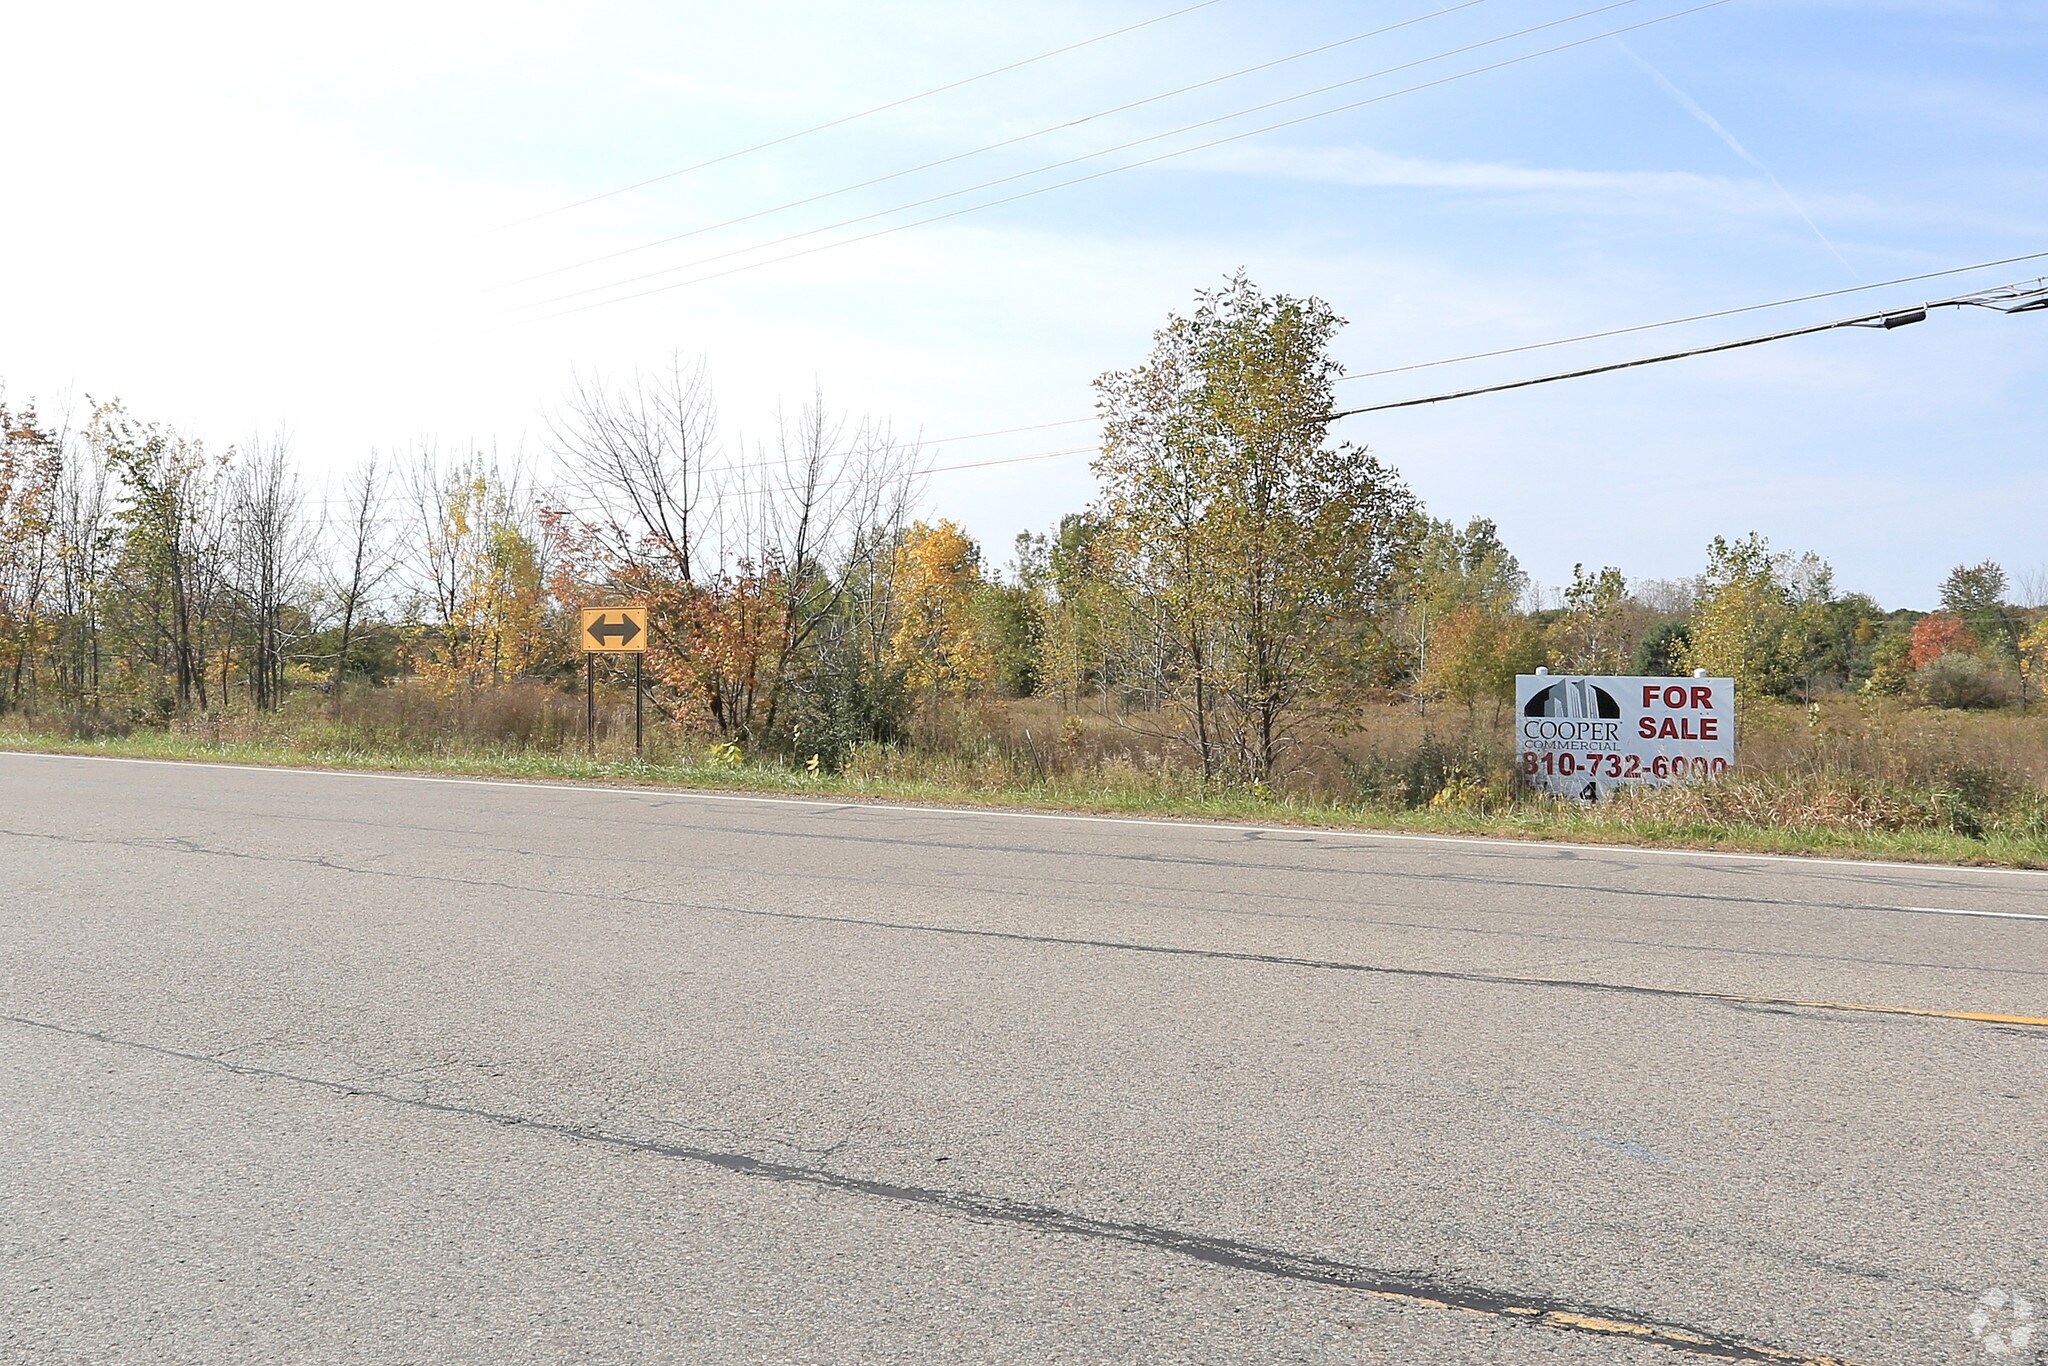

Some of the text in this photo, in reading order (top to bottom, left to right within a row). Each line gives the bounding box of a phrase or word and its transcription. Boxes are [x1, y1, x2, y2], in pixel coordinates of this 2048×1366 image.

[1643, 686, 1713, 709] FOR
[1524, 721, 1619, 741] COOPER
[1638, 717, 1718, 740] SALE
[1524, 740, 1621, 751] COMMERCIAL
[1522, 752, 1728, 780] 810-732-6000
